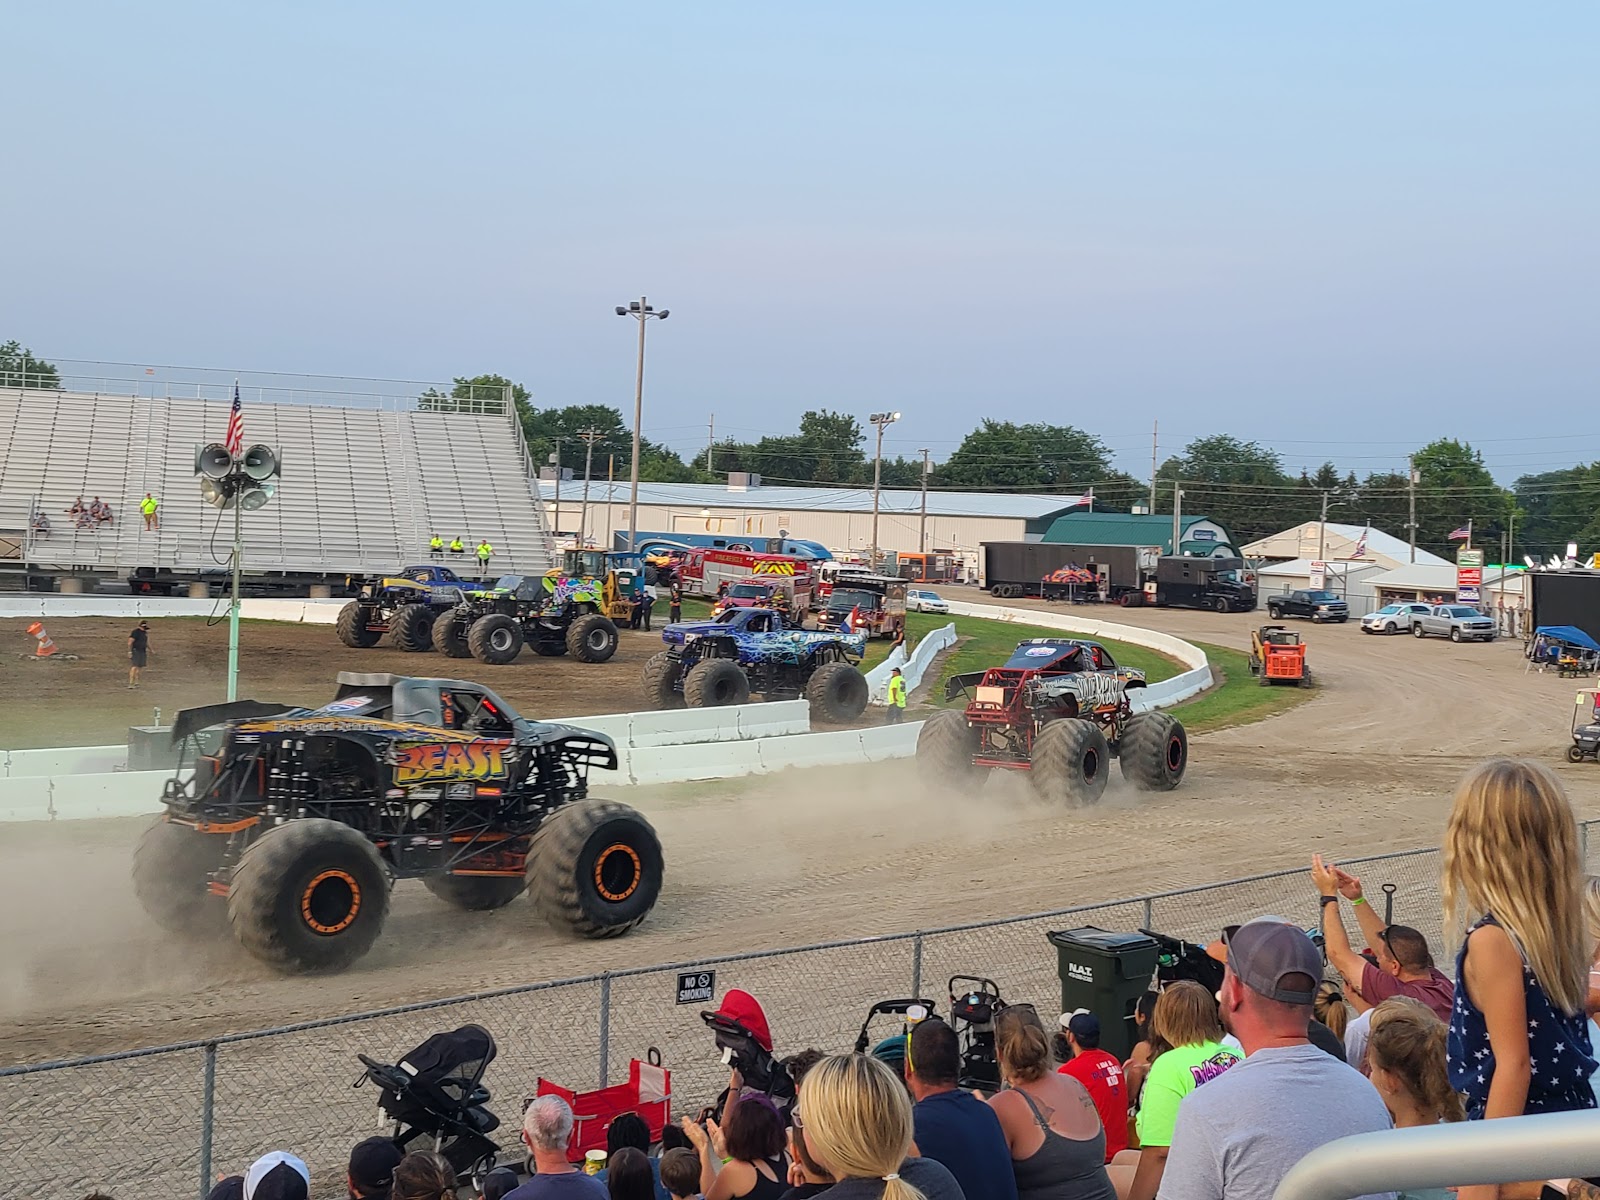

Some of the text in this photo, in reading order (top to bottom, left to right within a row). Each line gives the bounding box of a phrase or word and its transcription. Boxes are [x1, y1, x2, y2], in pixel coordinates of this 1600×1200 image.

[395, 738, 512, 784] BEAST
[685, 977, 696, 988] NO
[680, 987, 712, 1001] SMOKING
